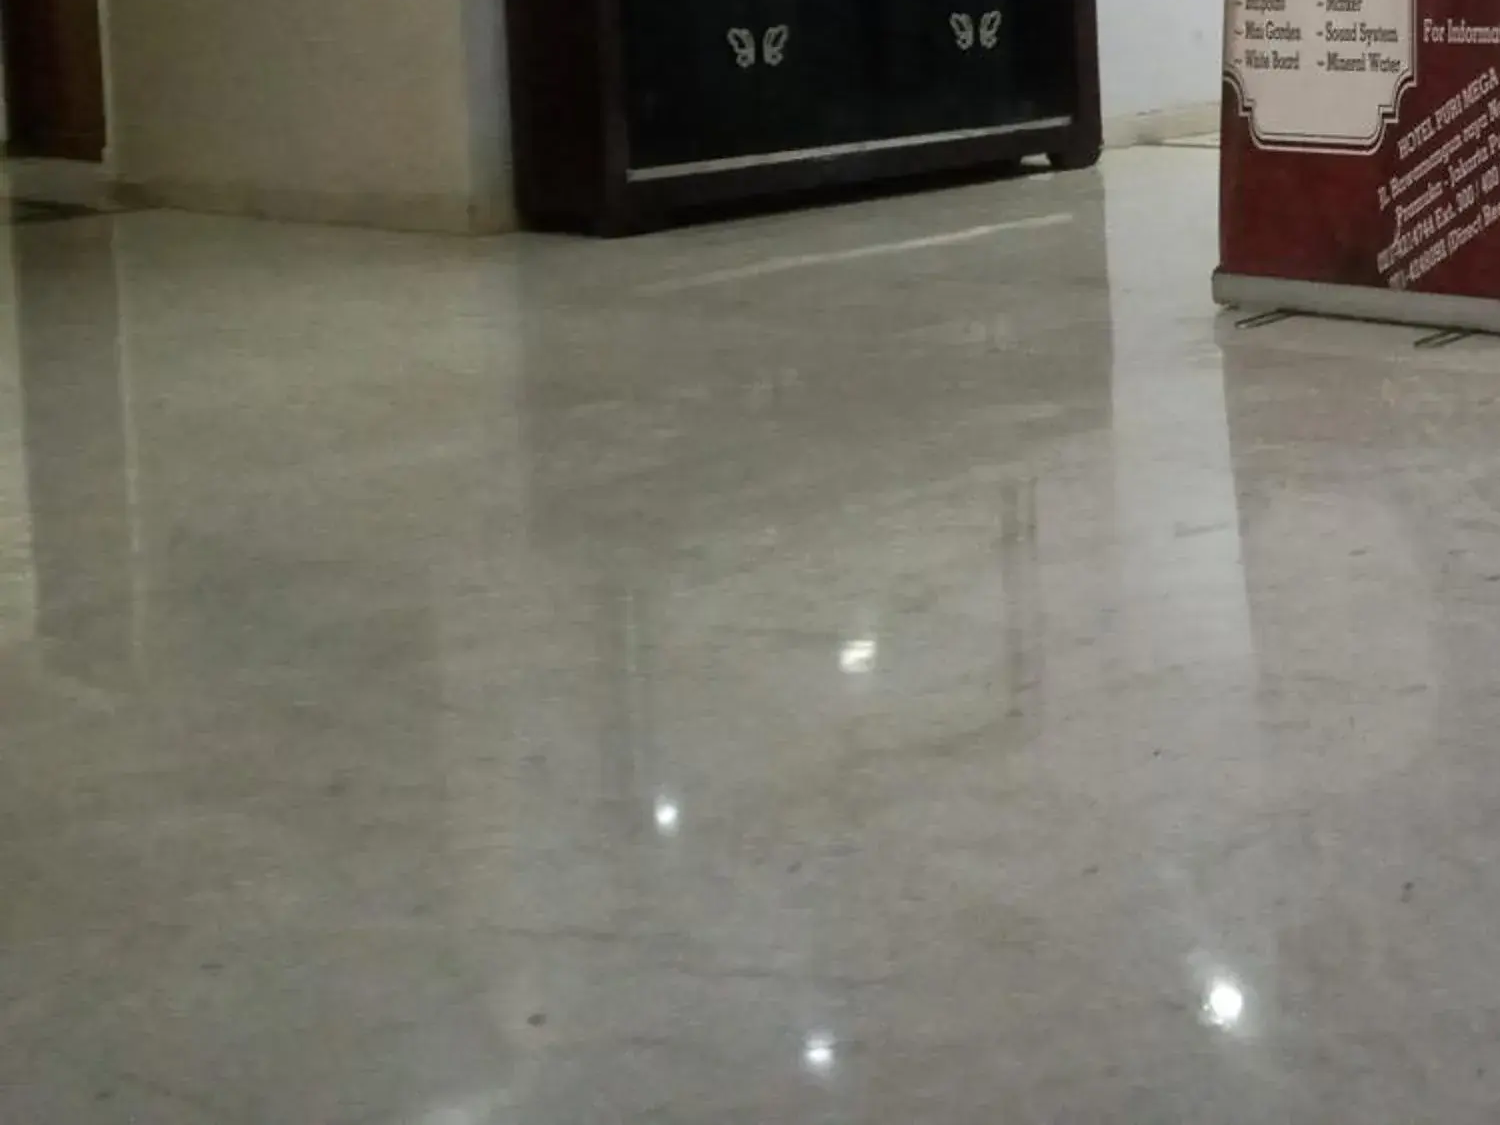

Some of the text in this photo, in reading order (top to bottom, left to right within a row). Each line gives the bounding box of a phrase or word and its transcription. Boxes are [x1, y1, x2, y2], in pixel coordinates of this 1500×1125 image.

[1325, 21, 1398, 47] Sound System
[1423, 18, 1445, 44] For
[1245, 49, 1300, 70] White Board
[1326, 51, 1401, 73] Mineral Water
[1397, 66, 1500, 160] HOTEL PURI MEGA
